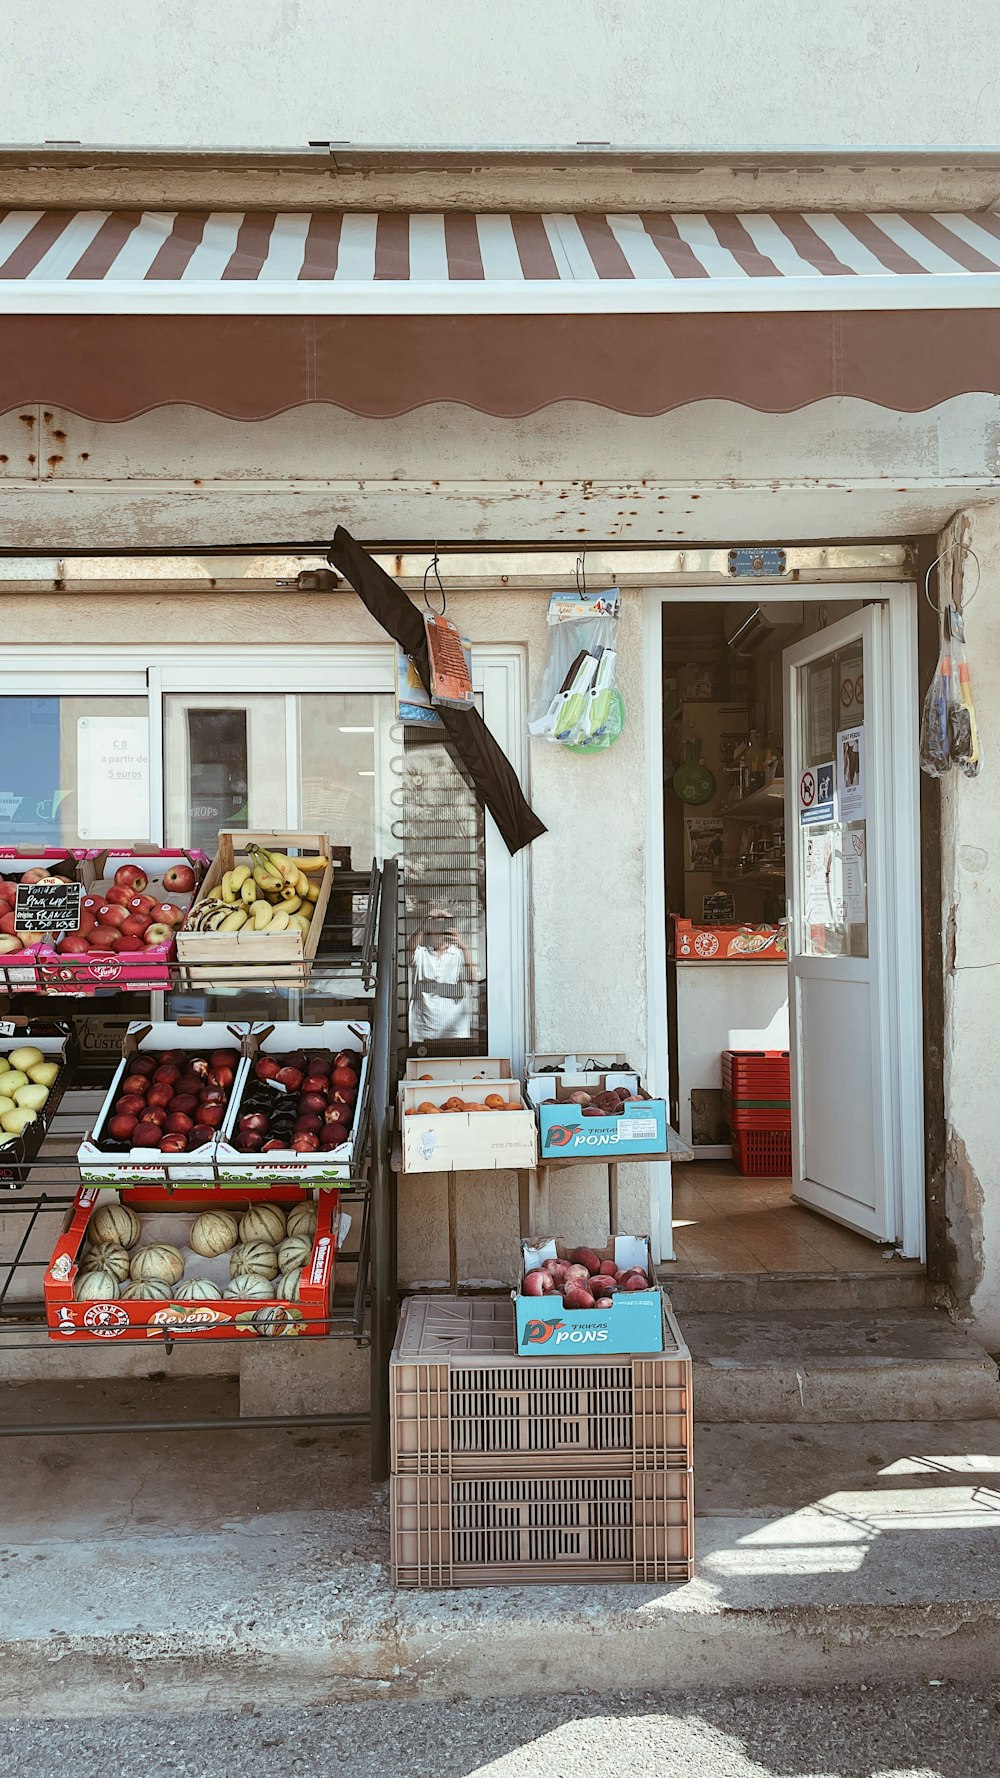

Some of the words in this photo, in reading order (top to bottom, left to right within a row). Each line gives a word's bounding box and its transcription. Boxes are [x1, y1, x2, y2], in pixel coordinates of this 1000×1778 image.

[108, 754, 134, 764] partir
[136, 754, 148, 763] de
[108, 770, 114, 778] 5
[36, 910, 72, 920] FRANCE
[574, 1134, 620, 1147] PONS
[555, 1330, 608, 1344] PONS
